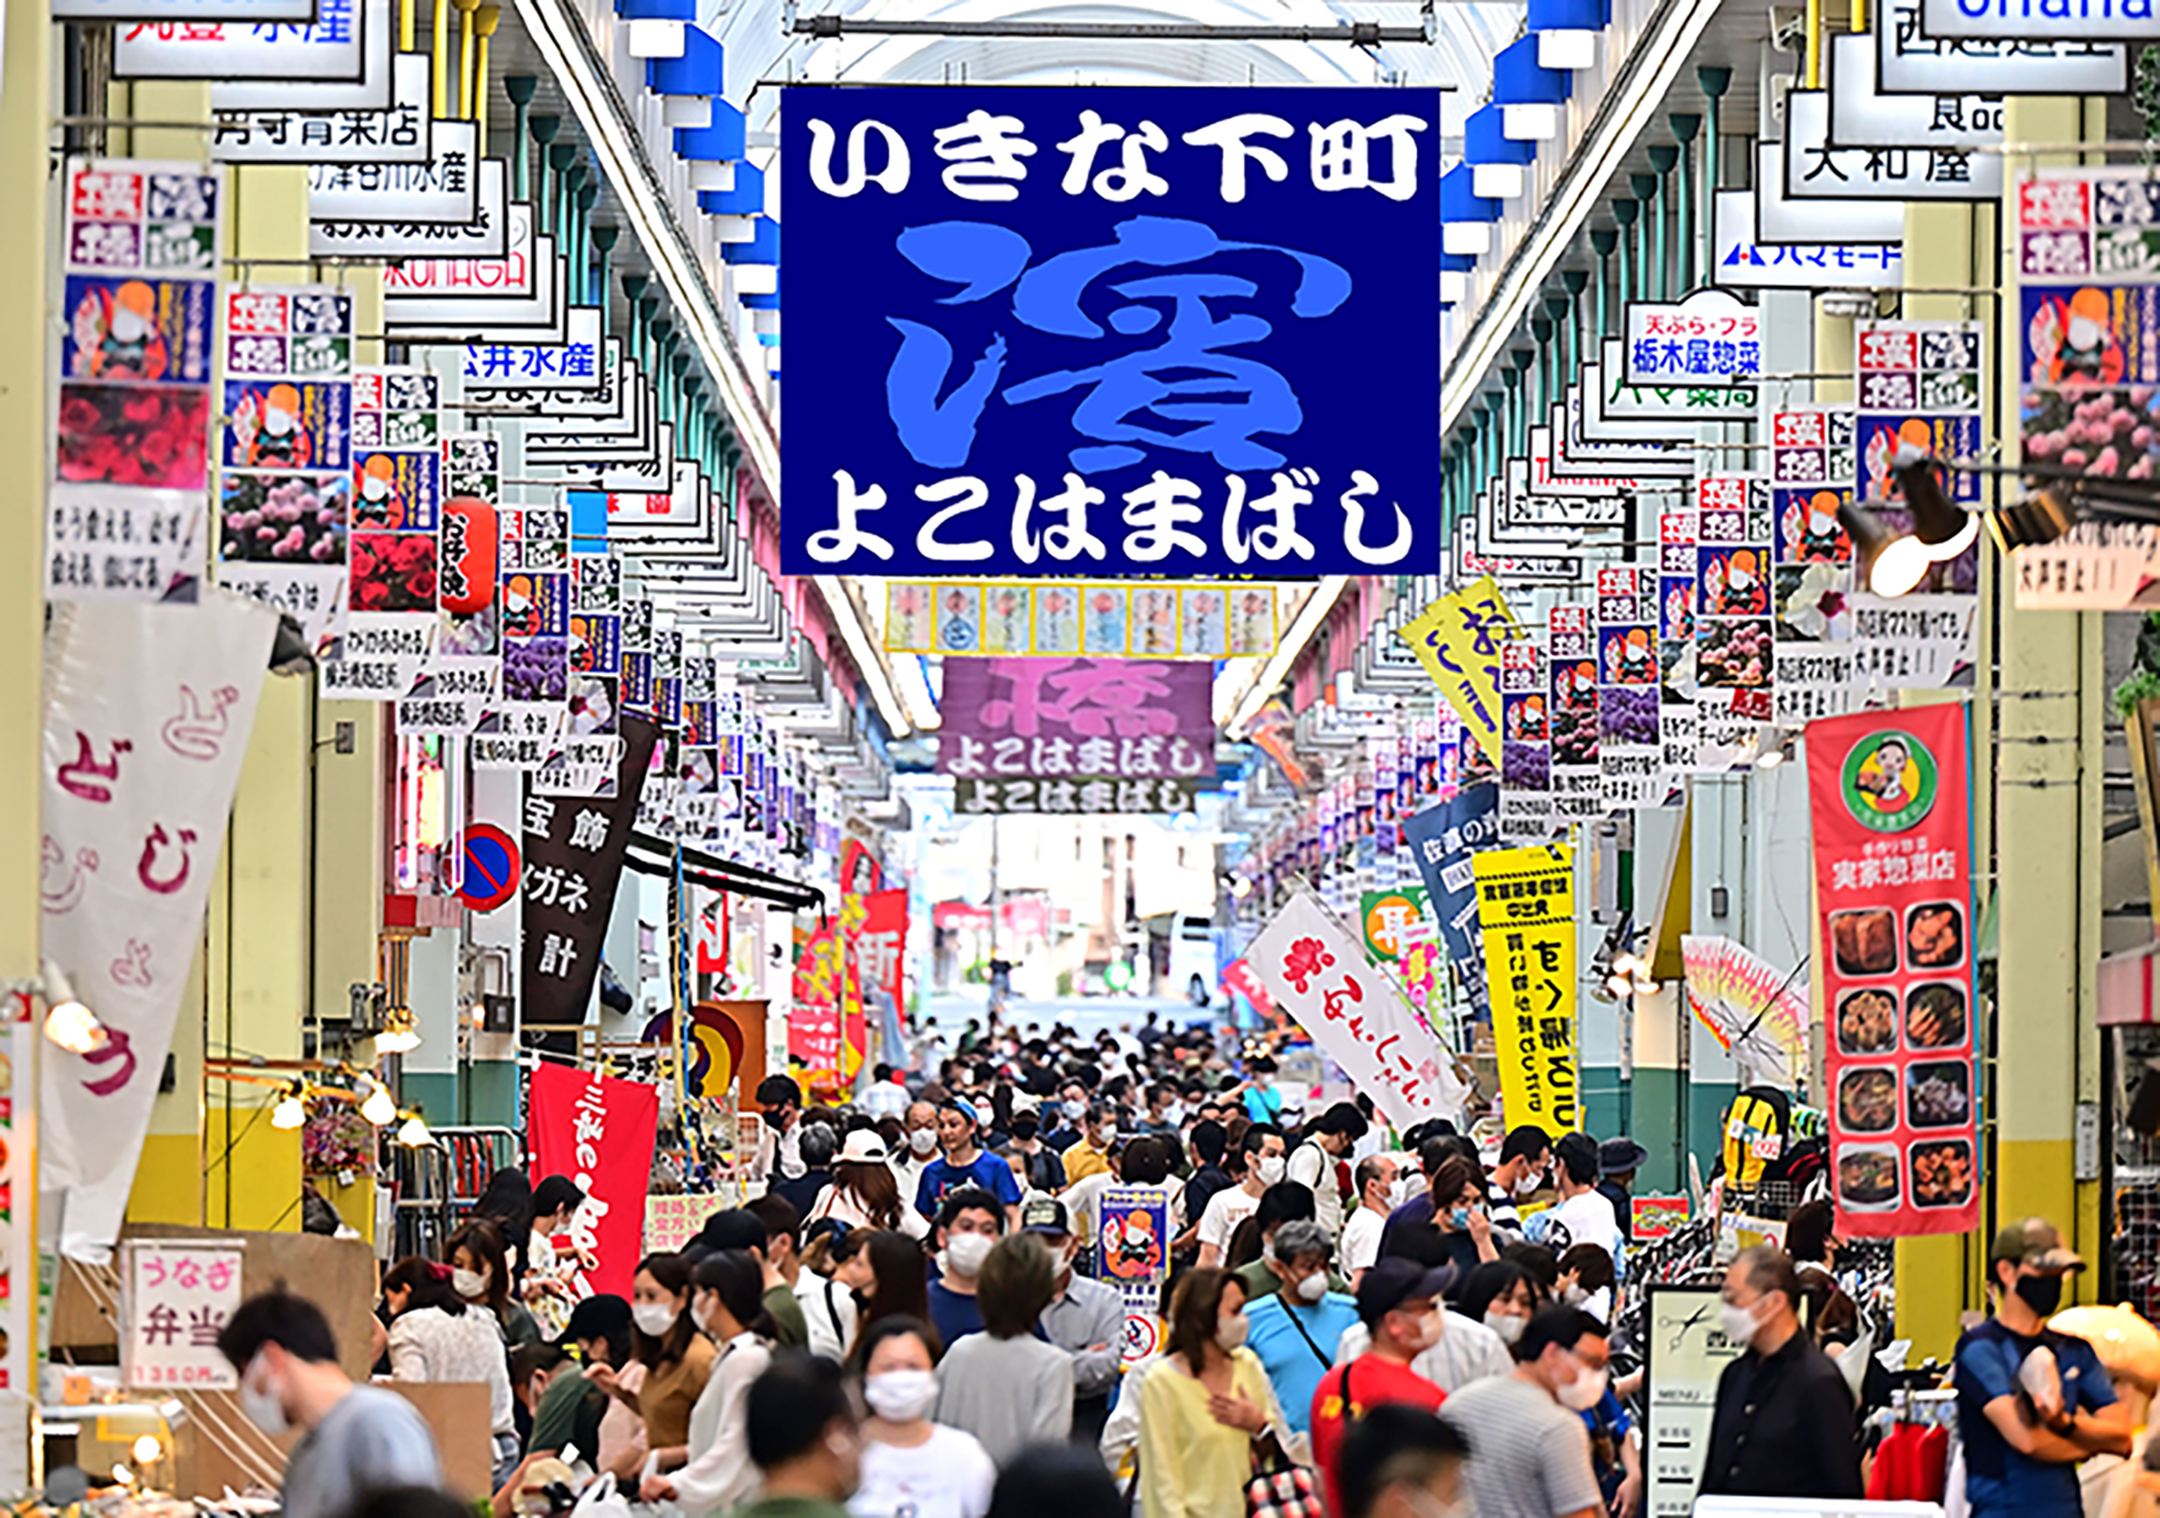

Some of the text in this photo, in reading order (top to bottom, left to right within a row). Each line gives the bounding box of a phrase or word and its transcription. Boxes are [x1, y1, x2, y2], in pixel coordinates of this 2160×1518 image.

[806, 108, 1428, 204] いきな下町
[1632, 337, 1760, 375] 栃木屋惣菜
[806, 466, 1413, 565] よこはまばし
[947, 734, 1205, 776] よこはまばし
[964, 779, 1189, 814] よこはまばし
[142, 1255, 239, 1293] うなぎ
[140, 1301, 225, 1347] 弁当
